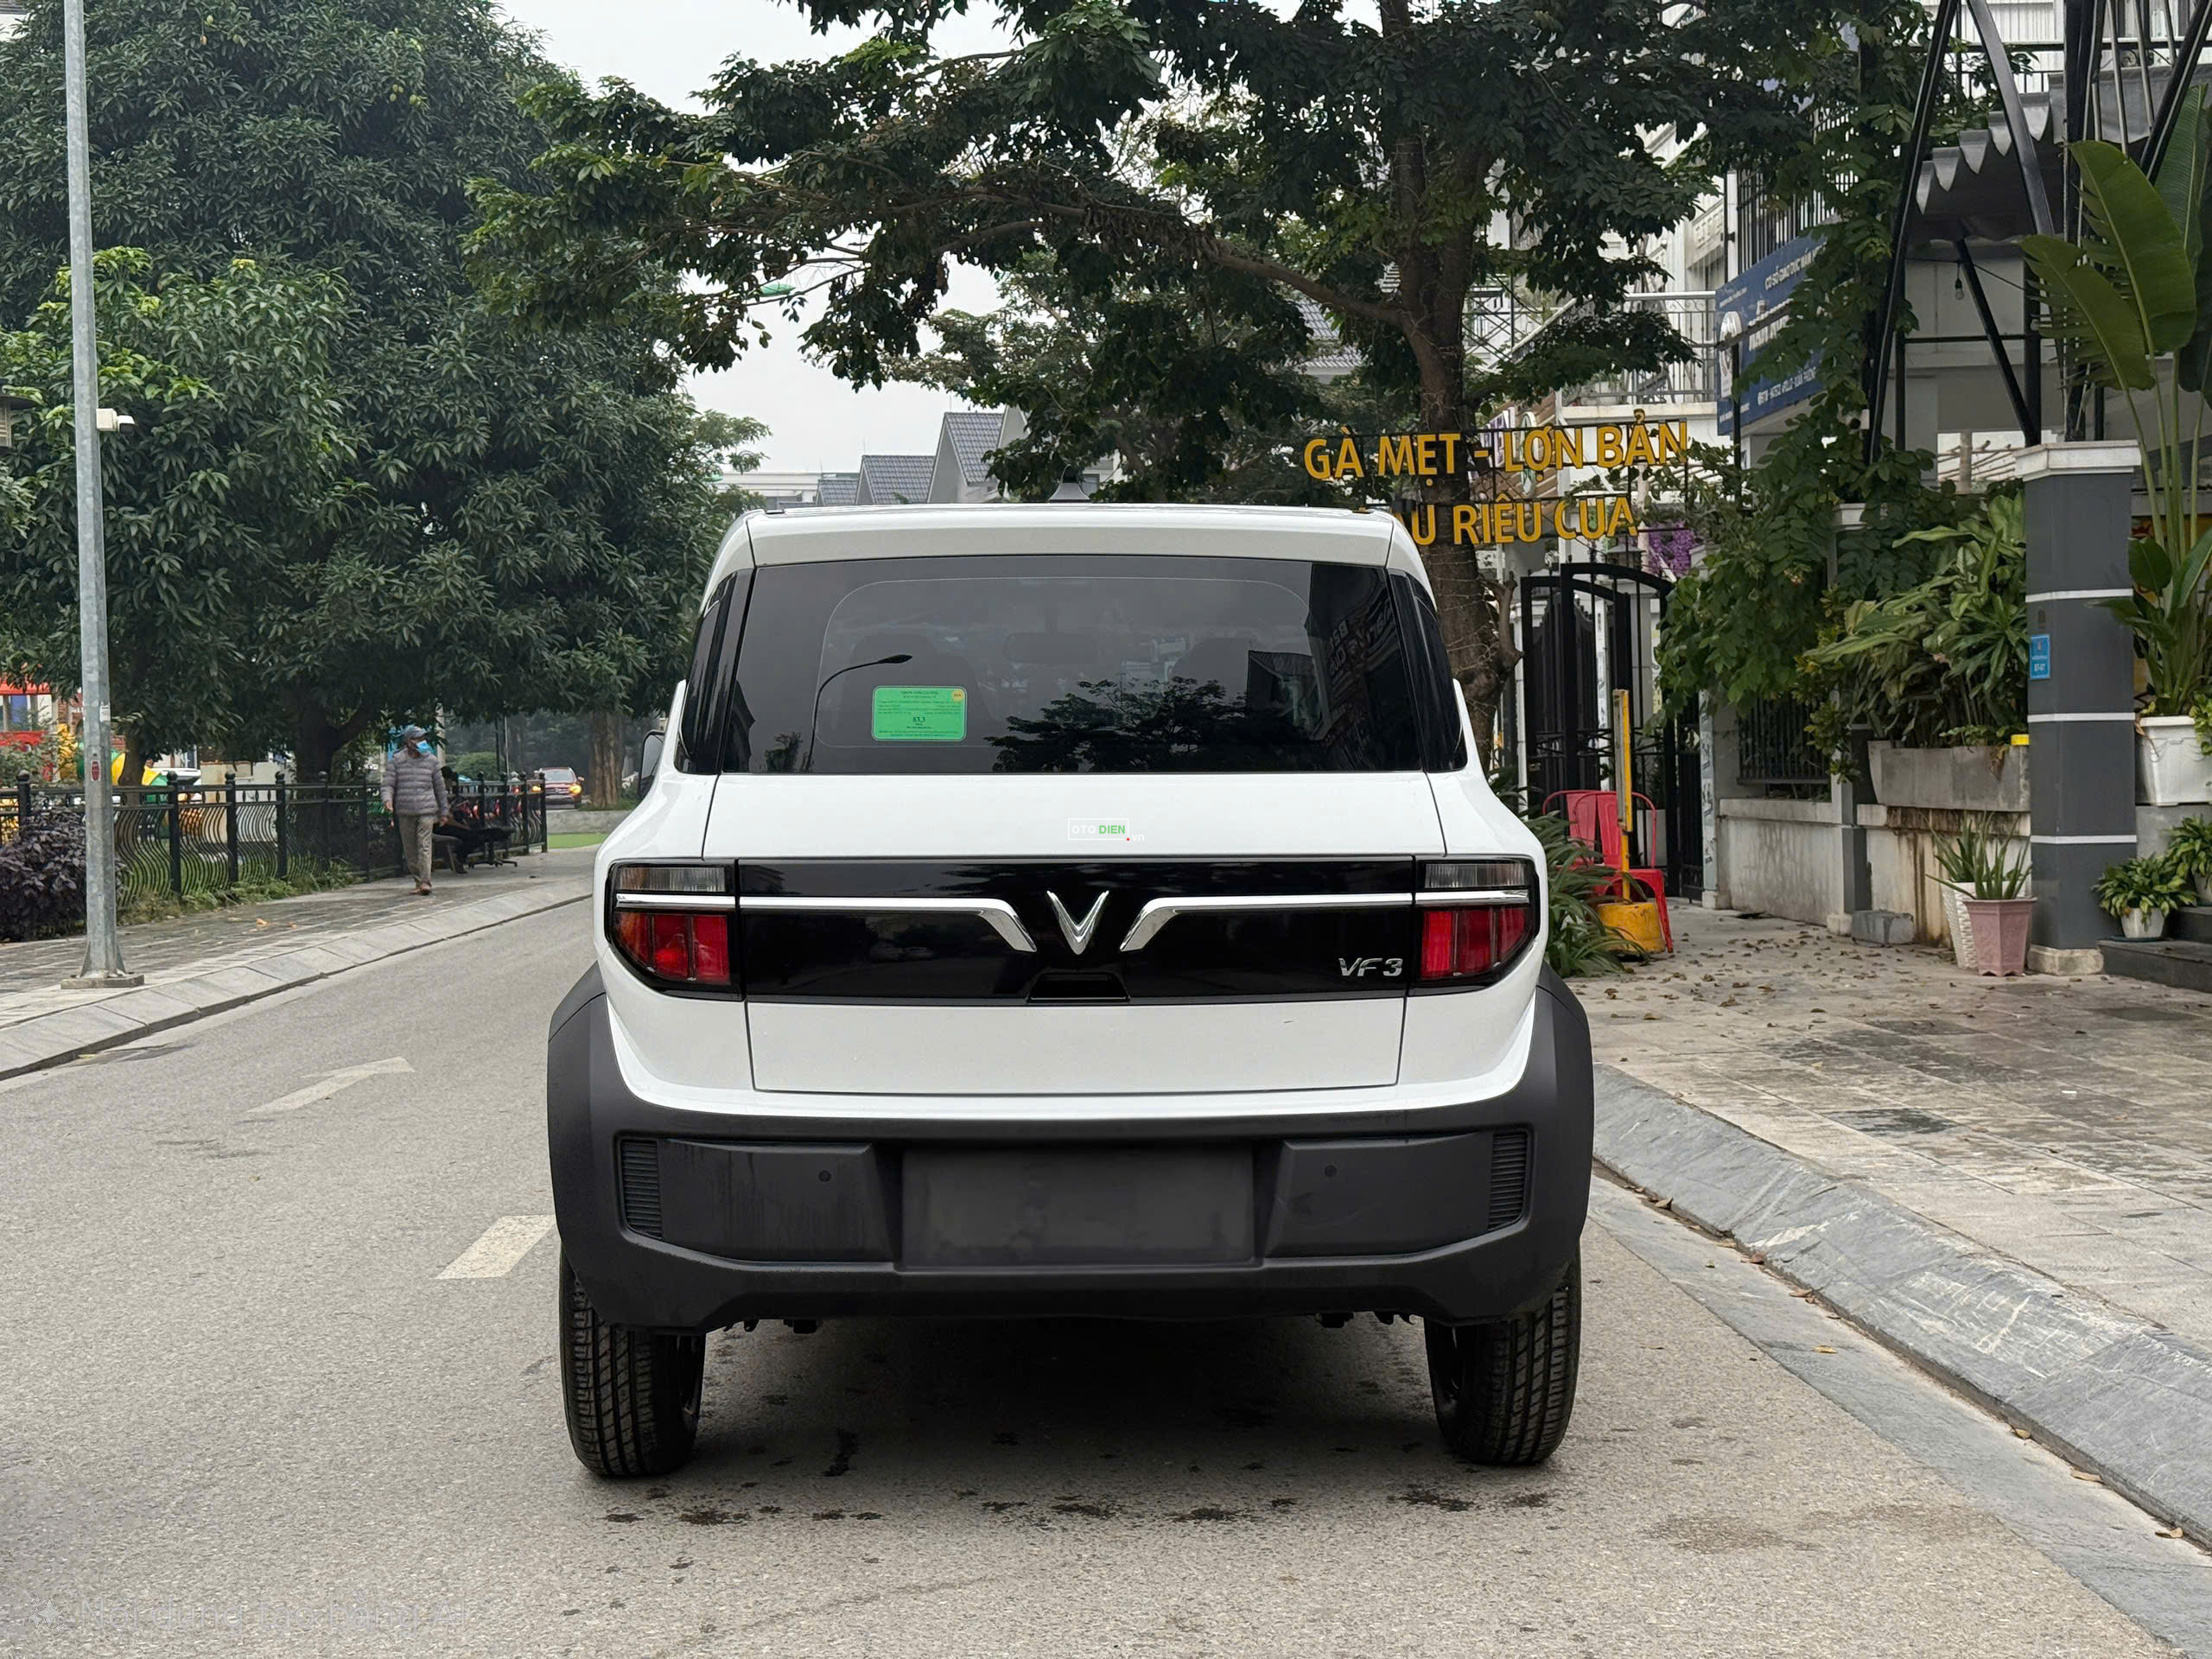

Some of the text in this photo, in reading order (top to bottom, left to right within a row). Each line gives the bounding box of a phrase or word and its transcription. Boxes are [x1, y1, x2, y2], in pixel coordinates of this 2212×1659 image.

[1304, 426, 1364, 479] GÀ
[1378, 433, 1460, 486] MẸT
[1504, 425, 1583, 481] LỢN
[1598, 409, 1687, 467] BẢN
[1390, 493, 1637, 545] U RIÊU CUA
